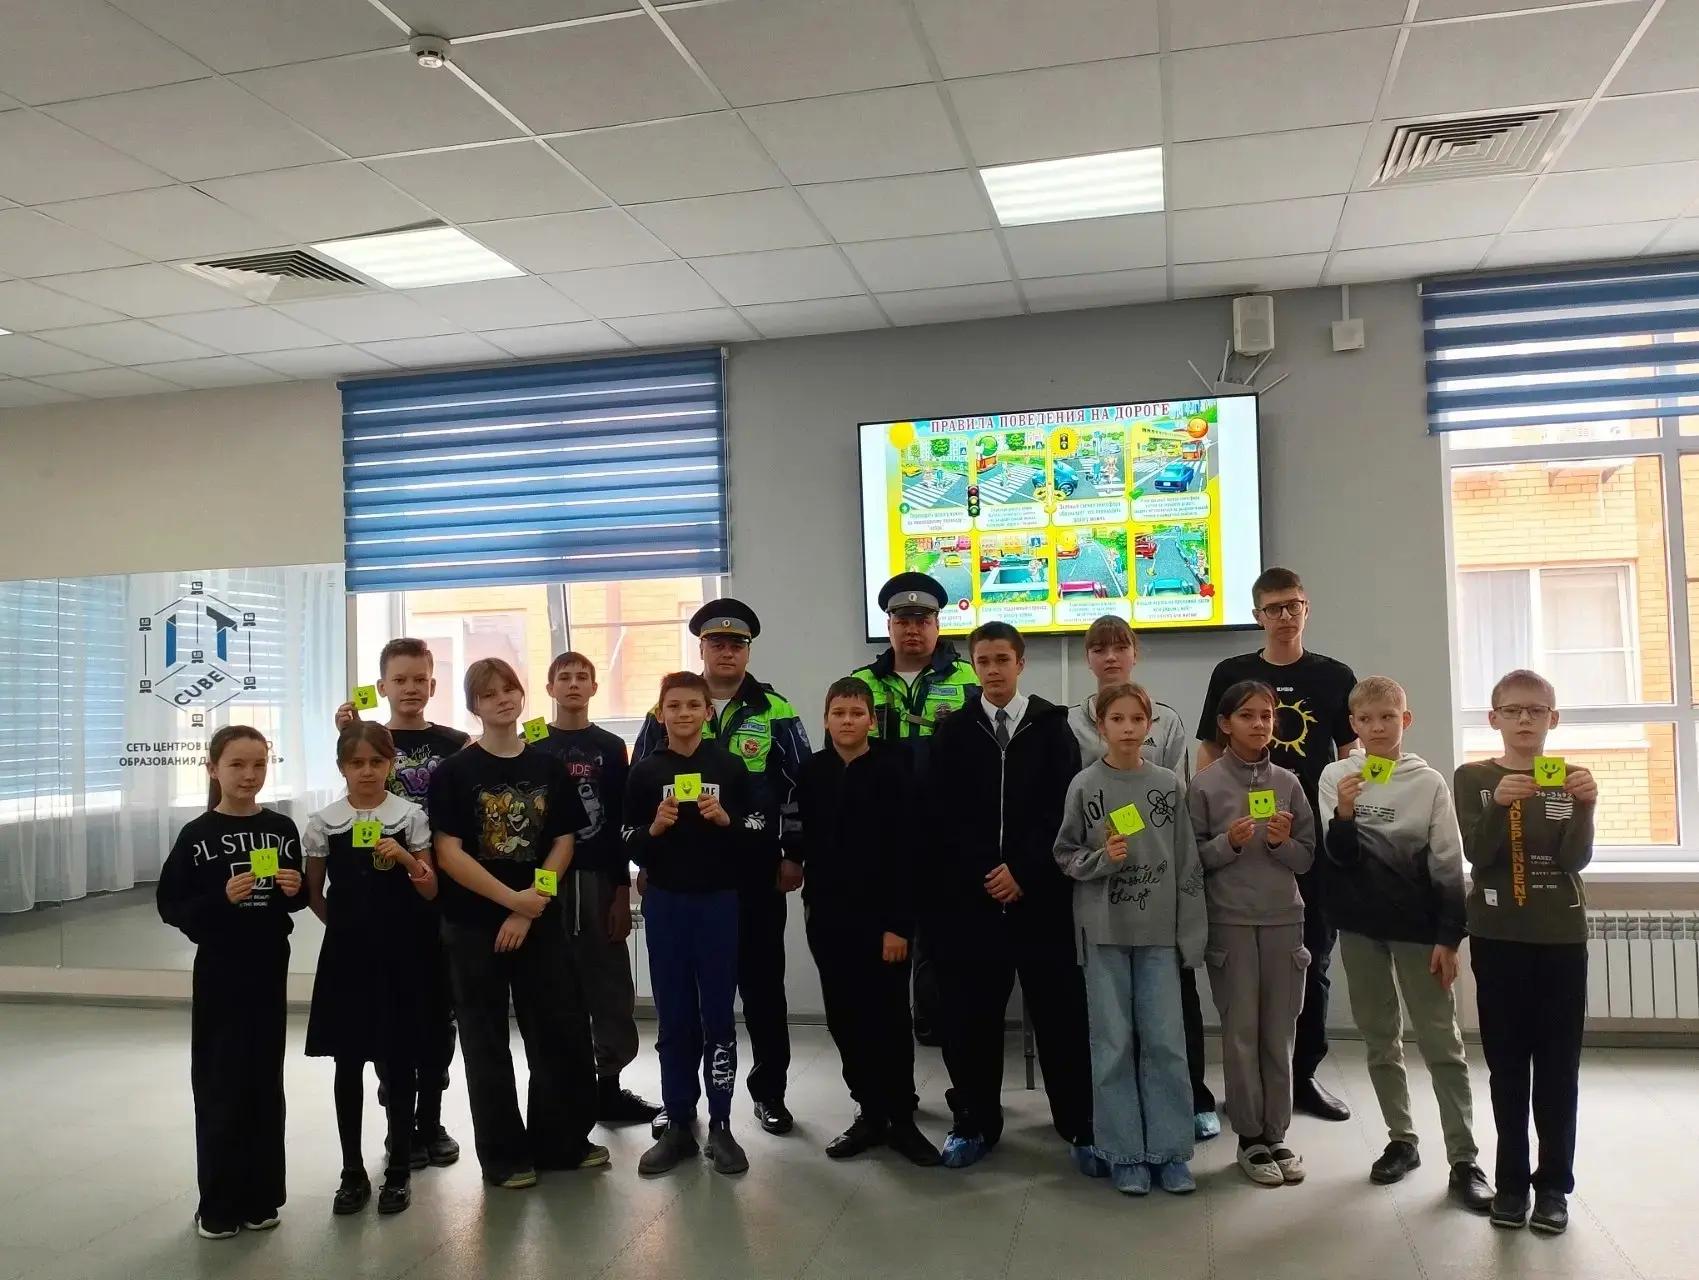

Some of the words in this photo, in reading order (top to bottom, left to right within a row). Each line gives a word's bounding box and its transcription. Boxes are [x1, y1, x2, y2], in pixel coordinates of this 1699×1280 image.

[931, 417, 993, 433] ПРАВИЛА
[1000, 410, 1085, 427] ПОВЕДЕНИЯ
[1091, 408, 1109, 421] НА
[1115, 403, 1170, 420] ДОРОГЕ
[174, 670, 225, 705] CUBE
[126, 742, 151, 752] СЕТЬ
[153, 741, 201, 753] ЦЕНТРОВ
[119, 756, 196, 767] ОБРАЗОВАНИЯ
